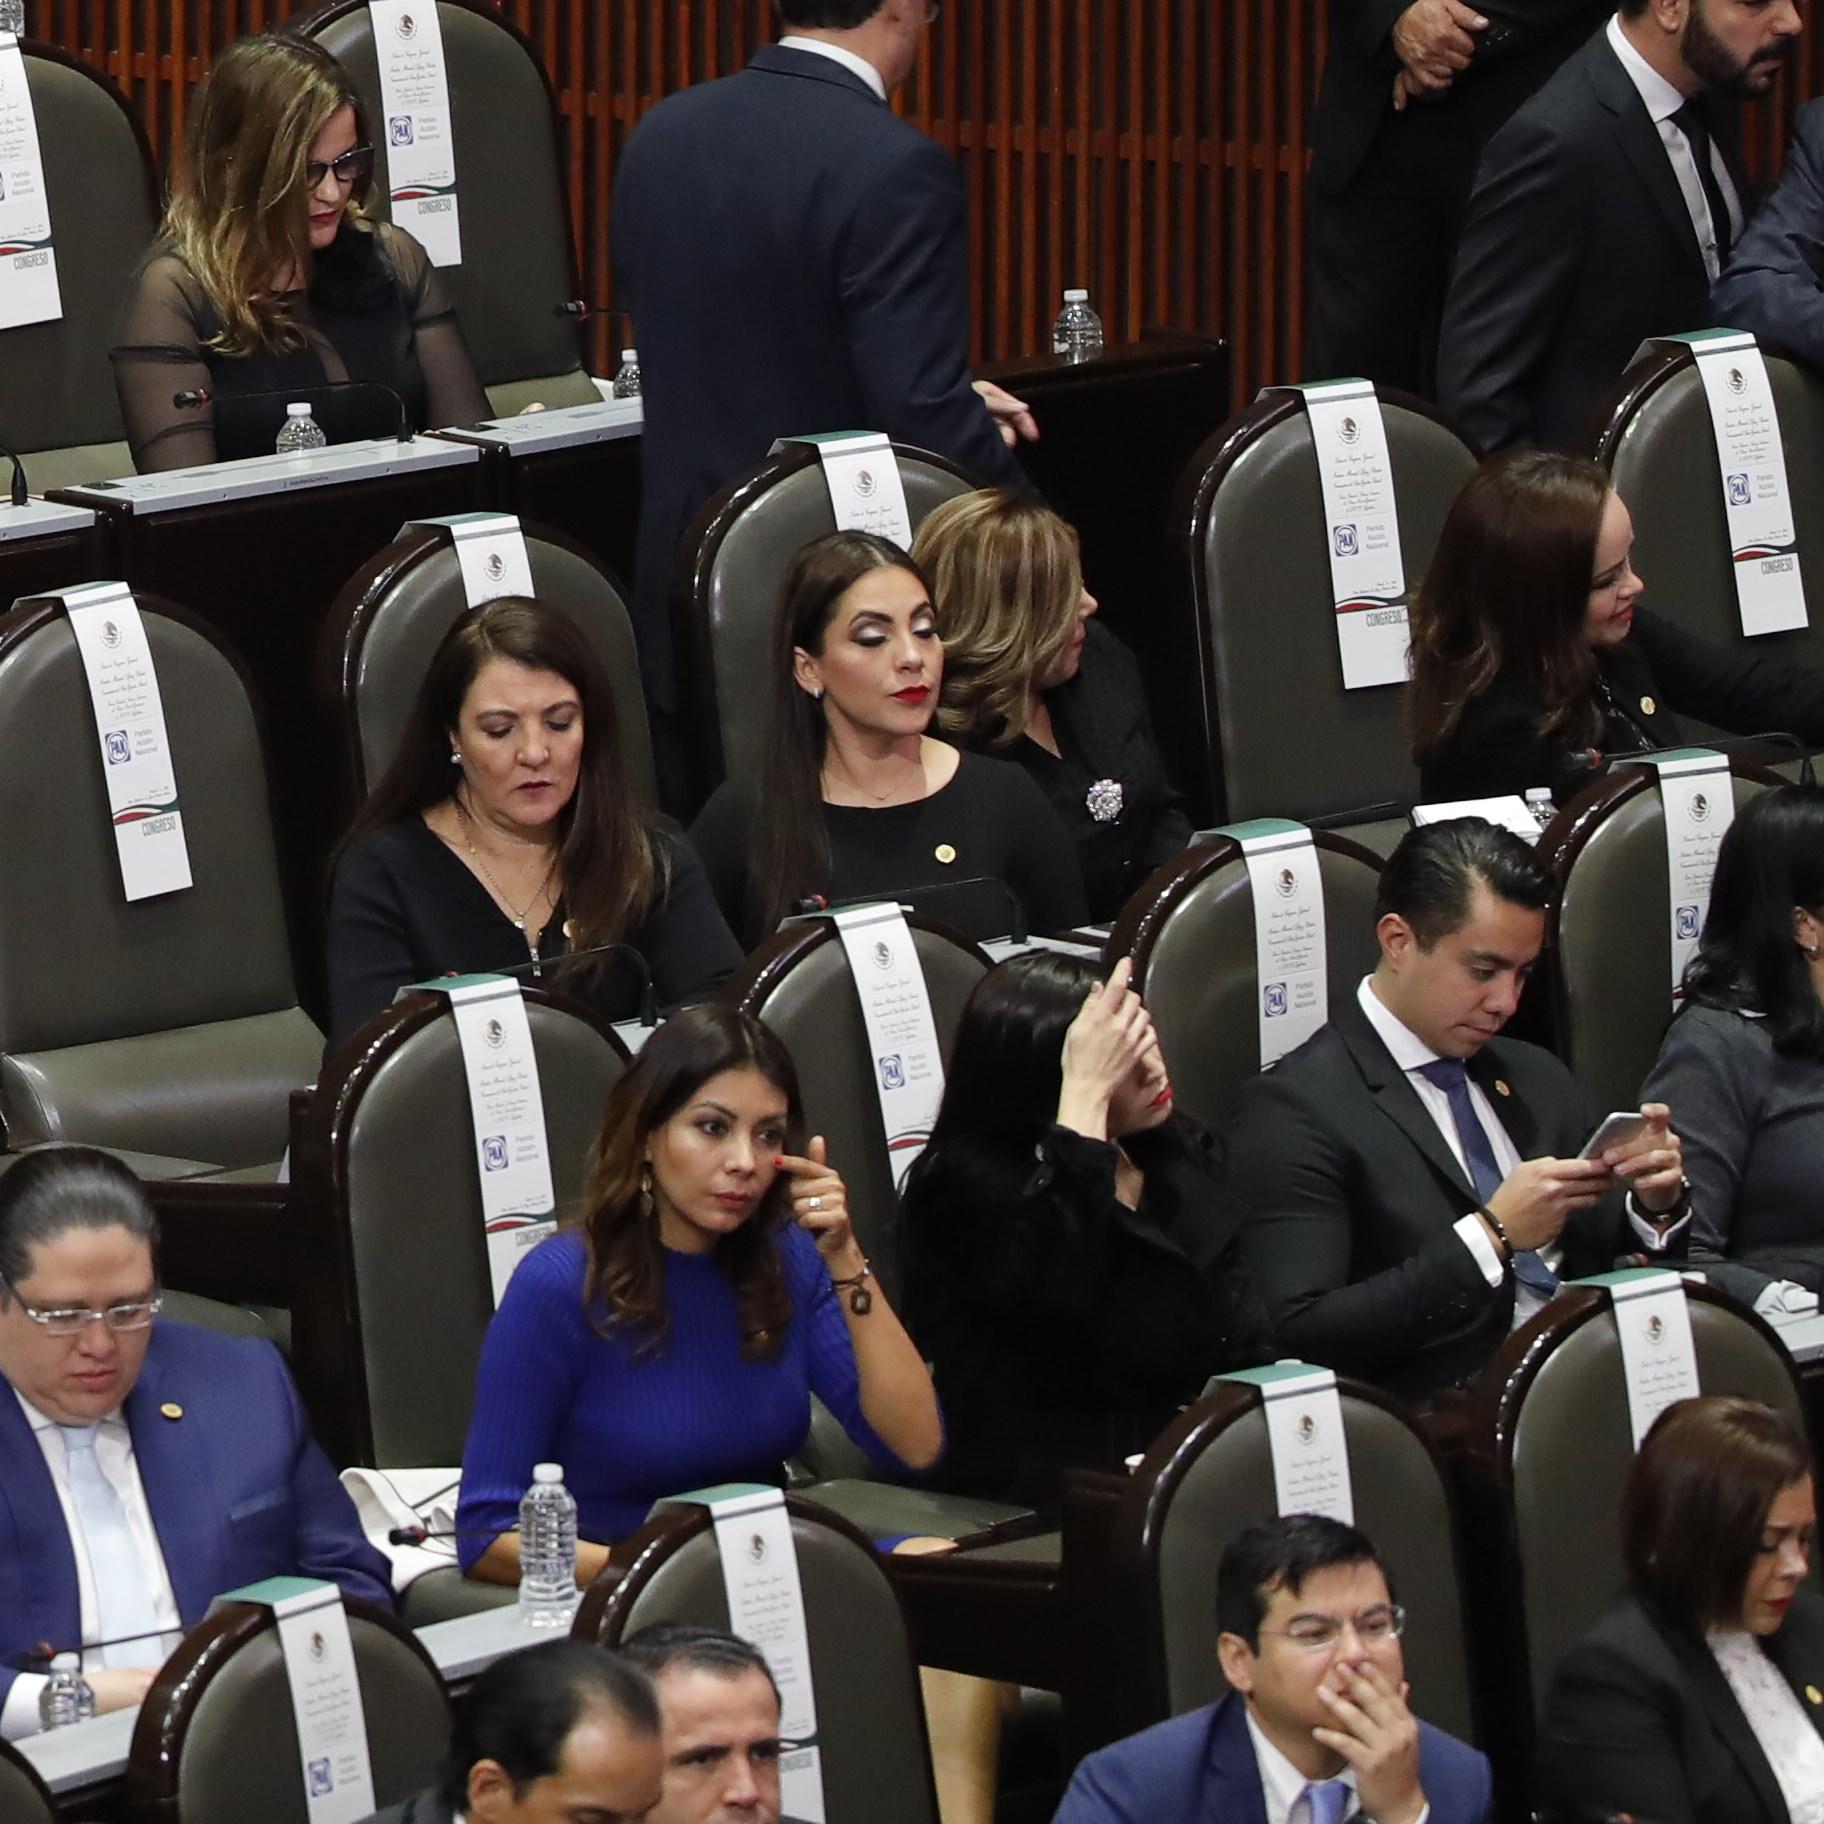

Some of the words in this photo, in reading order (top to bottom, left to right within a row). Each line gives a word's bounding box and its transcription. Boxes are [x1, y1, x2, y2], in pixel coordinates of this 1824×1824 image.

[395, 124, 408, 137] PAN
[417, 198, 452, 215] CONGRESO
[13, 251, 49, 270] CONGRESO
[1733, 482, 1746, 496] PAN
[1339, 532, 1354, 546] PAN
[1760, 557, 1793, 575] CONGRESO
[1366, 609, 1401, 627] CONGRESO
[111, 741, 126, 754] PAN
[142, 816, 176, 837] CONGRESO
[1269, 993, 1282, 1006] PAN
